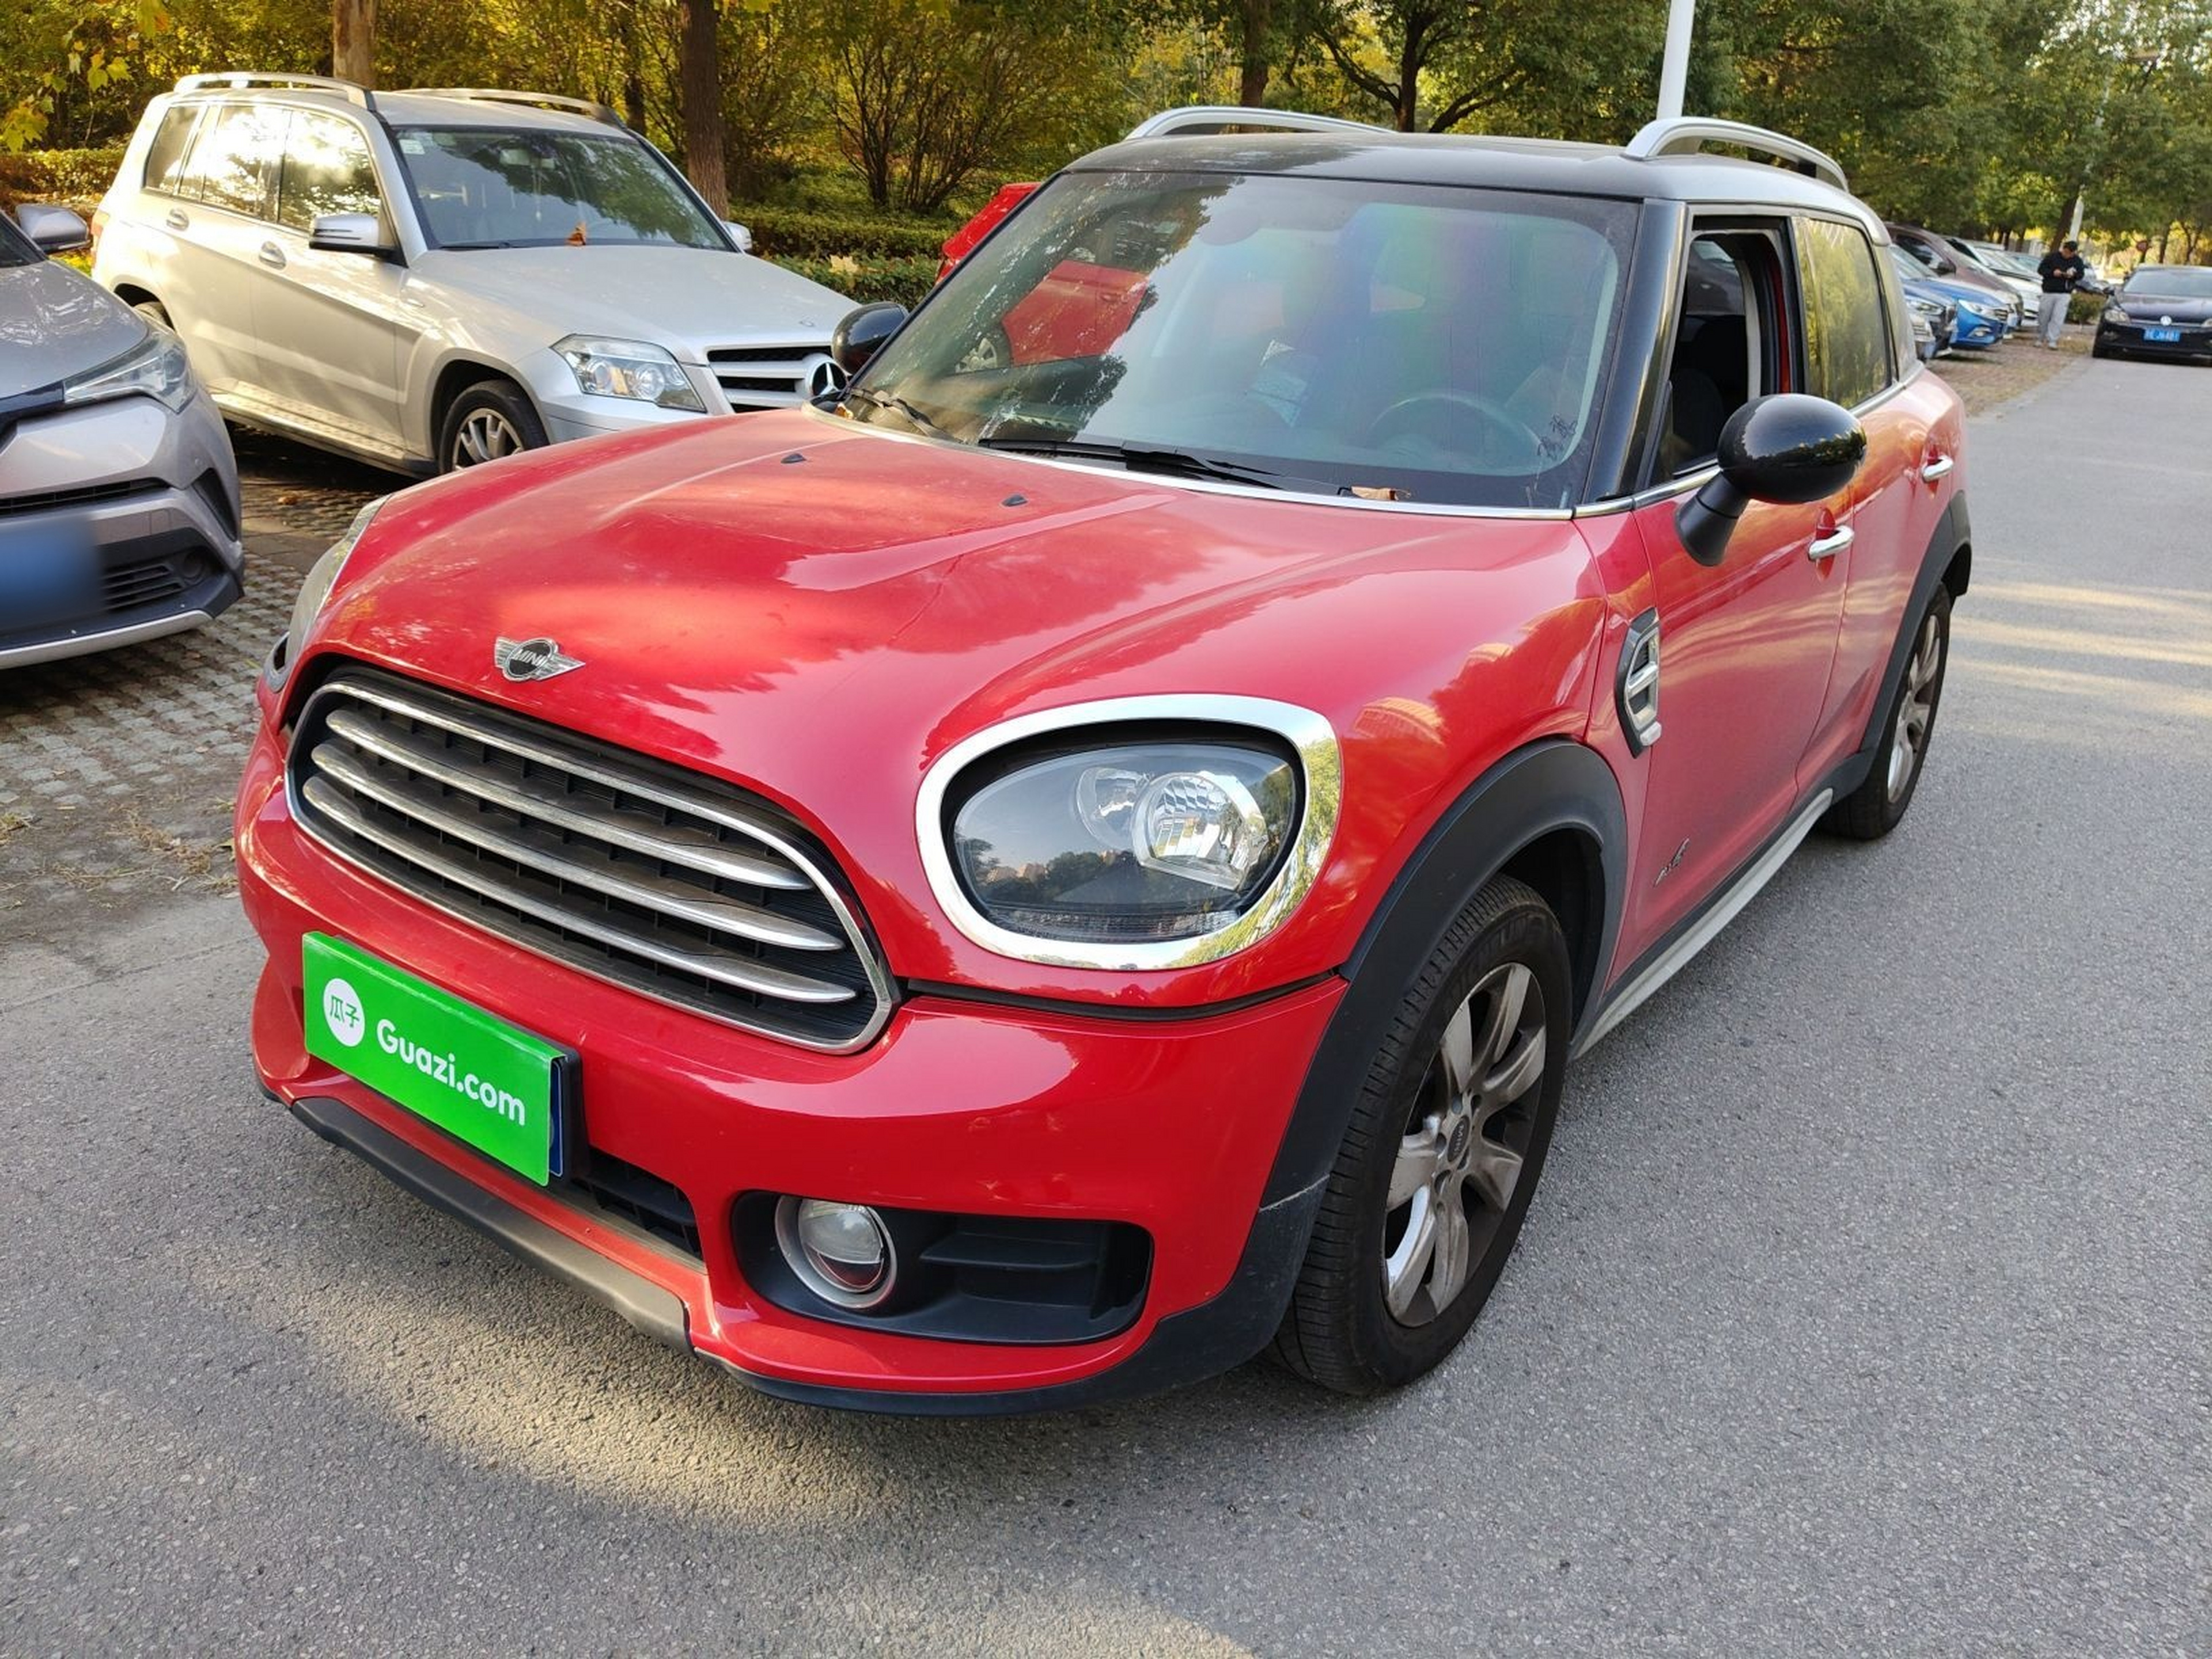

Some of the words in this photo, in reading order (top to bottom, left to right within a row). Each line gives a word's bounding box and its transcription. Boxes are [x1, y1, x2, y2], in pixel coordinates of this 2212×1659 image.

[512, 649, 547, 665] MINI
[331, 995, 359, 1027] 瓜子
[377, 1019, 525, 1126] Guazi.com
